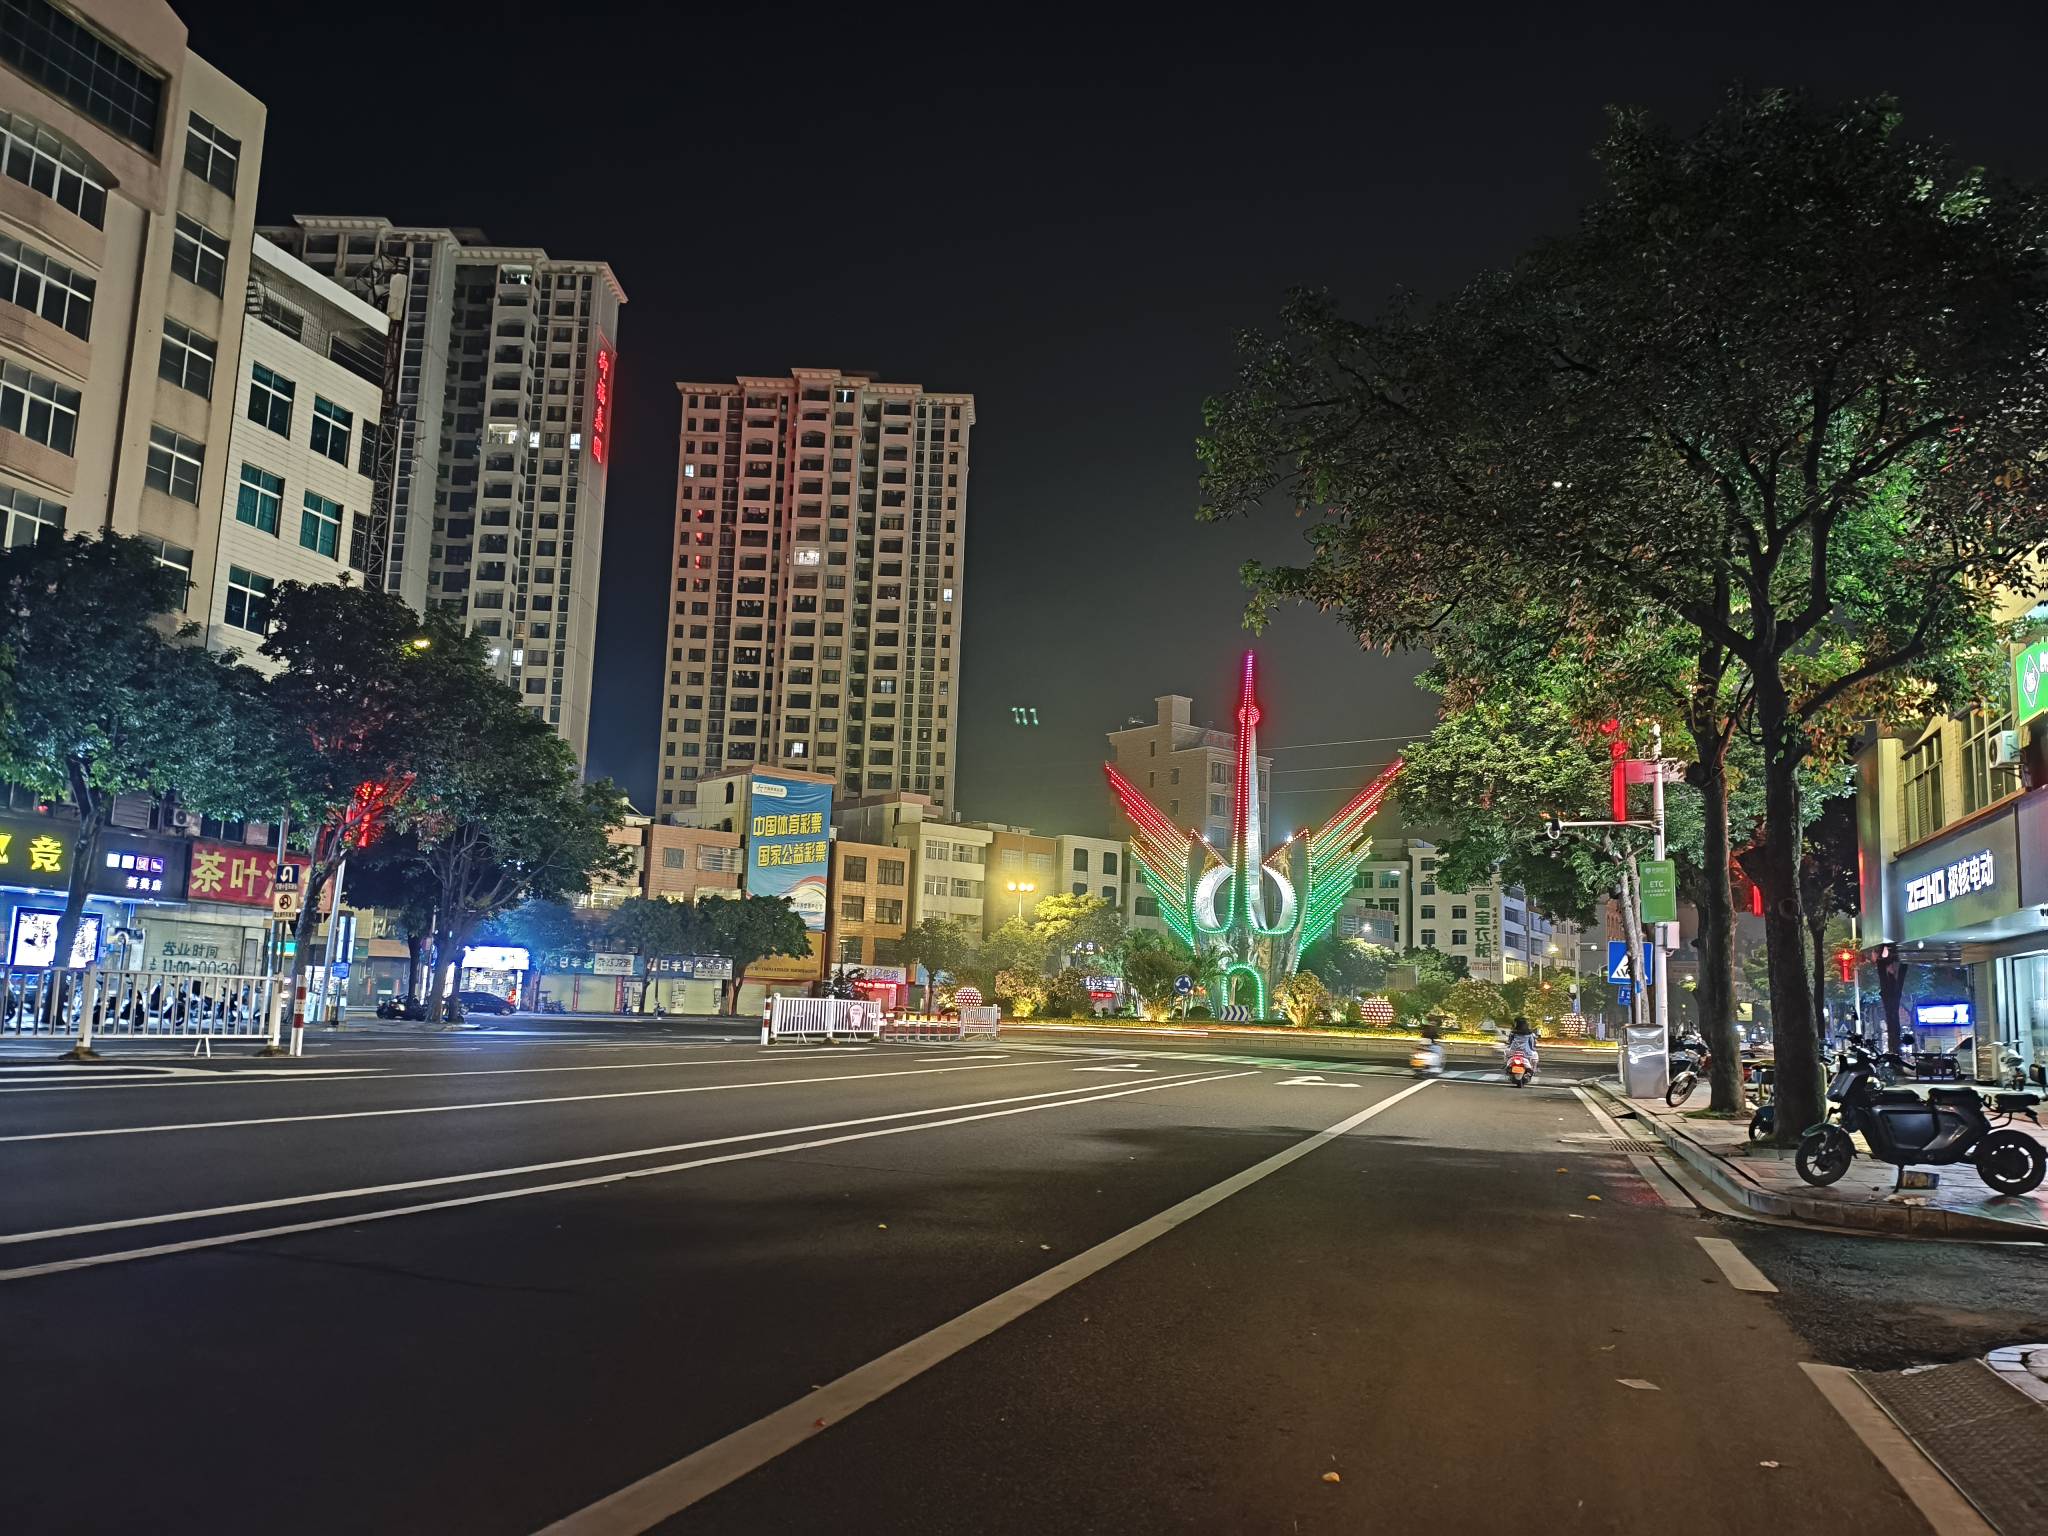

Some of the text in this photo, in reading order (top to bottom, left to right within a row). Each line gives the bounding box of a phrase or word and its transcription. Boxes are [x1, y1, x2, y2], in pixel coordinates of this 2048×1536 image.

[752, 812, 823, 837] 中国体育彩票
[757, 841, 827, 867] 国家公益彩票
[1649, 880, 1665, 888] ETC
[1947, 849, 1994, 899] 极核电动
[162, 941, 219, 958] 营业时间
